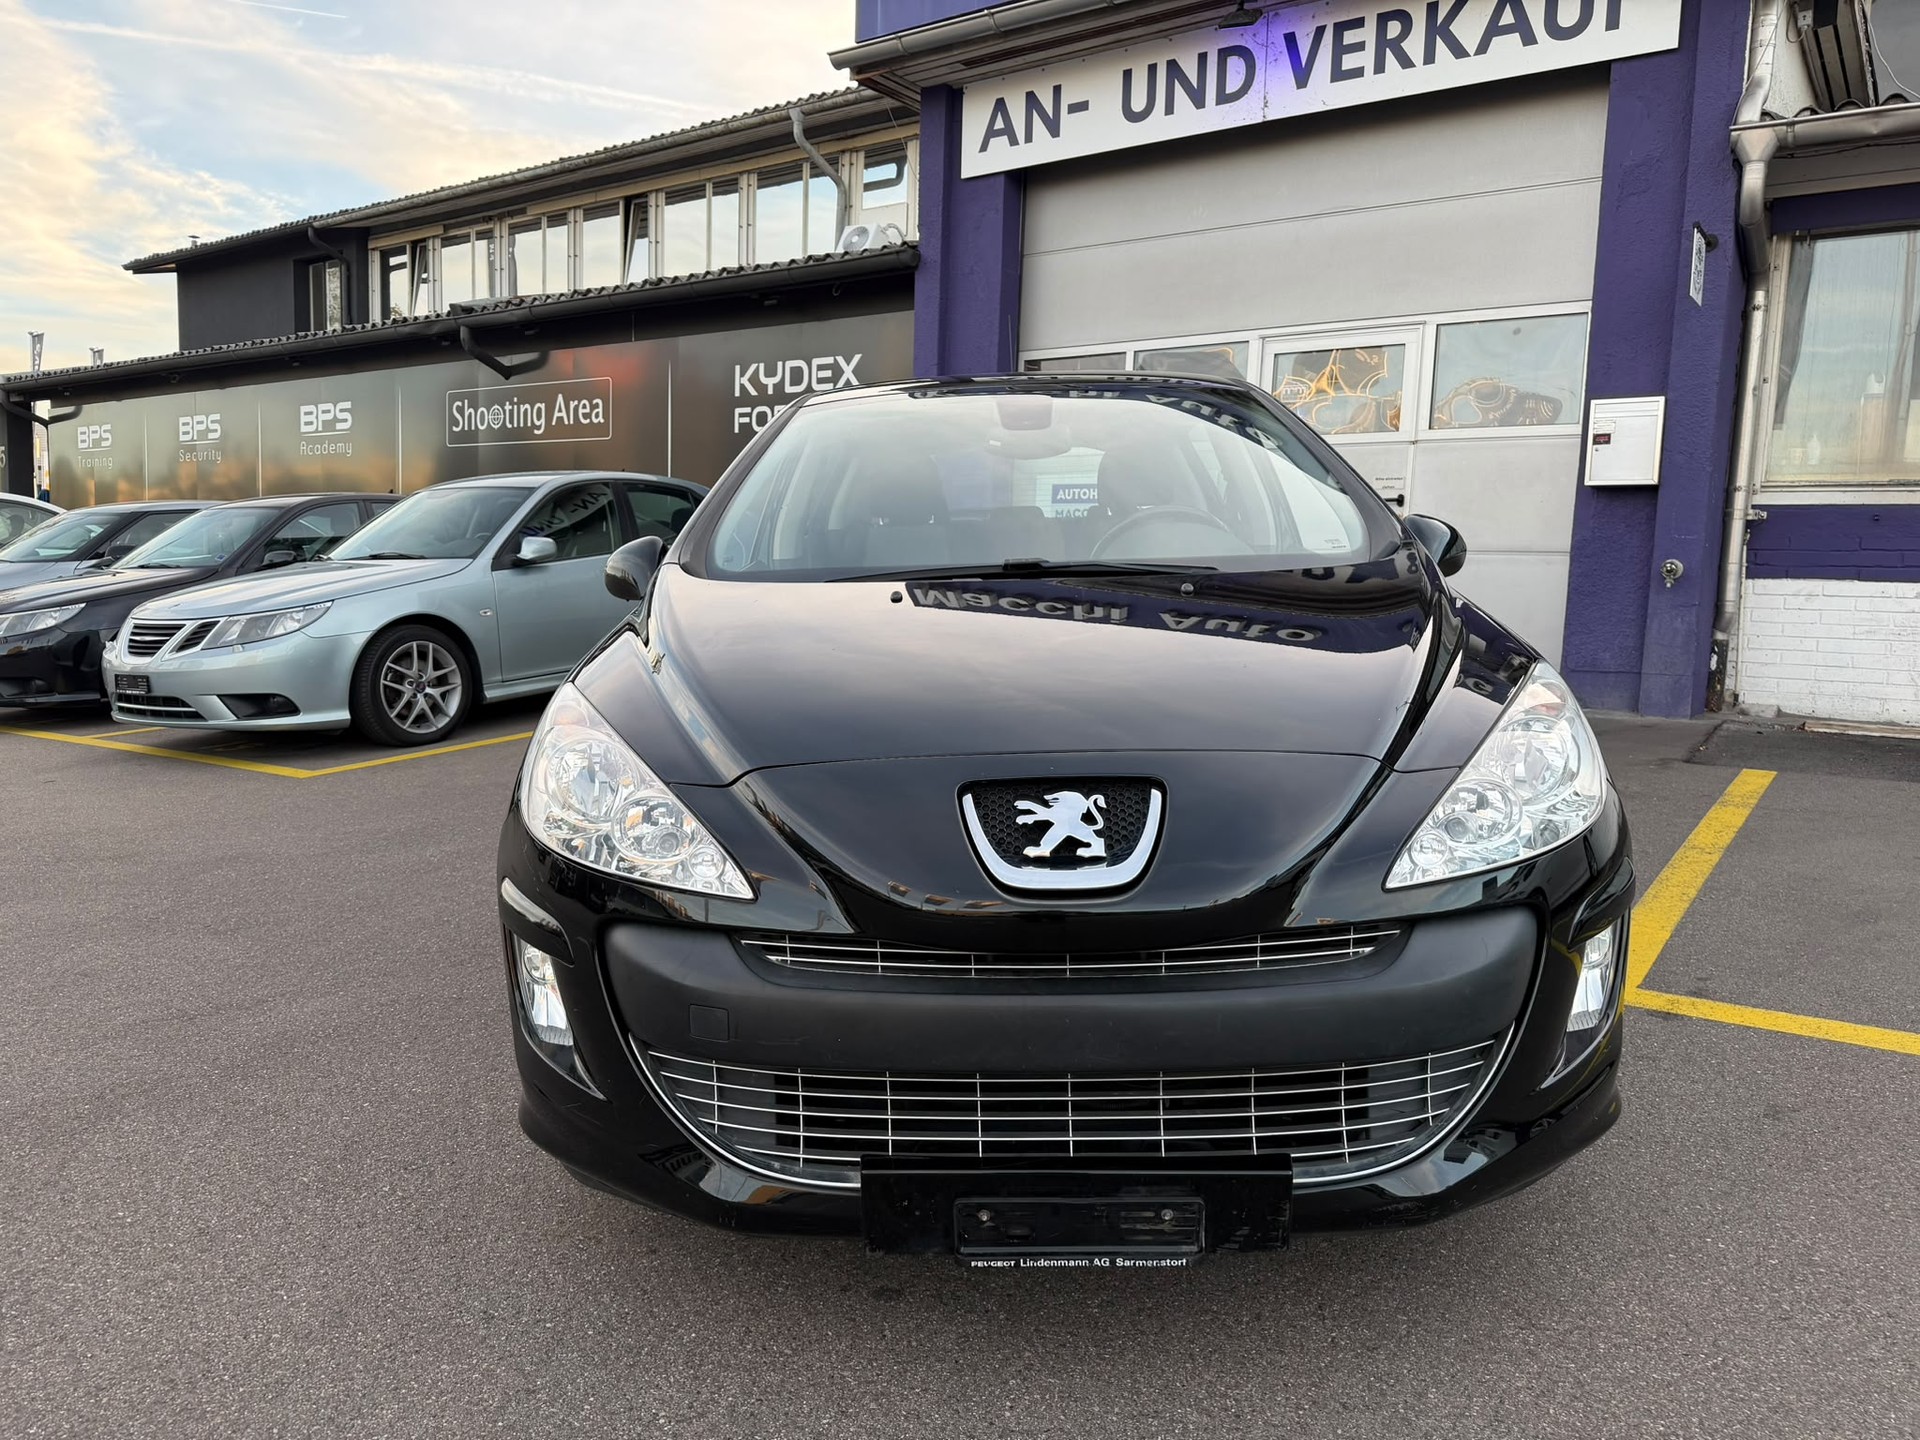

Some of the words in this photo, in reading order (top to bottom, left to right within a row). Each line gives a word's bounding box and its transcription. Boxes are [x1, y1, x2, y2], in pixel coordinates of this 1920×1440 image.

[978, 83, 1090, 153] AN-
[1121, 44, 1257, 124] UND
[734, 353, 862, 397] KYDEX
[300, 401, 353, 433] BPS
[552, 393, 605, 425] Area
[77, 424, 112, 448] BPS
[178, 413, 222, 441] BPS
[179, 449, 222, 463] Security
[300, 440, 352, 456] Academy
[78, 456, 113, 469] Training
[1020, 1258, 1090, 1267] Lindenmann
[1093, 1258, 1110, 1267] AG
